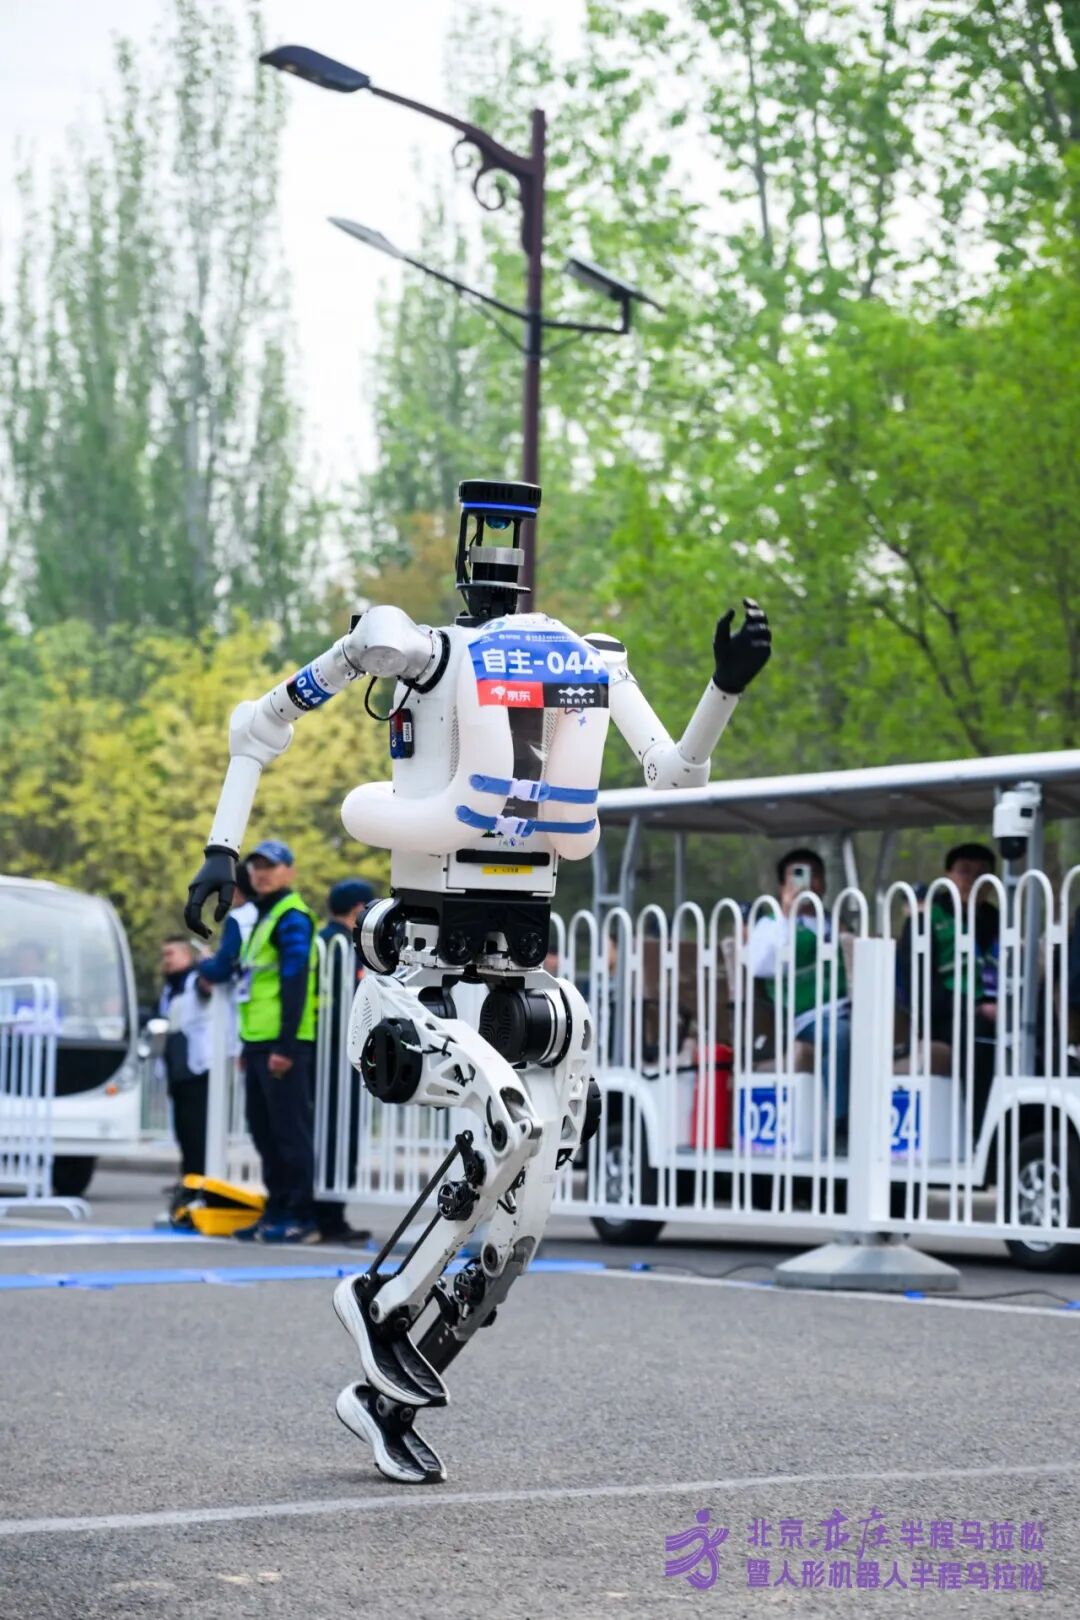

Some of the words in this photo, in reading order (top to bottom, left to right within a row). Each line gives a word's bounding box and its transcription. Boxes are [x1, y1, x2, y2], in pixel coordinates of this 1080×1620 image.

[482, 648, 600, 675] 自主-044
[297, 676, 322, 704] 044
[507, 690, 531, 702] 京东
